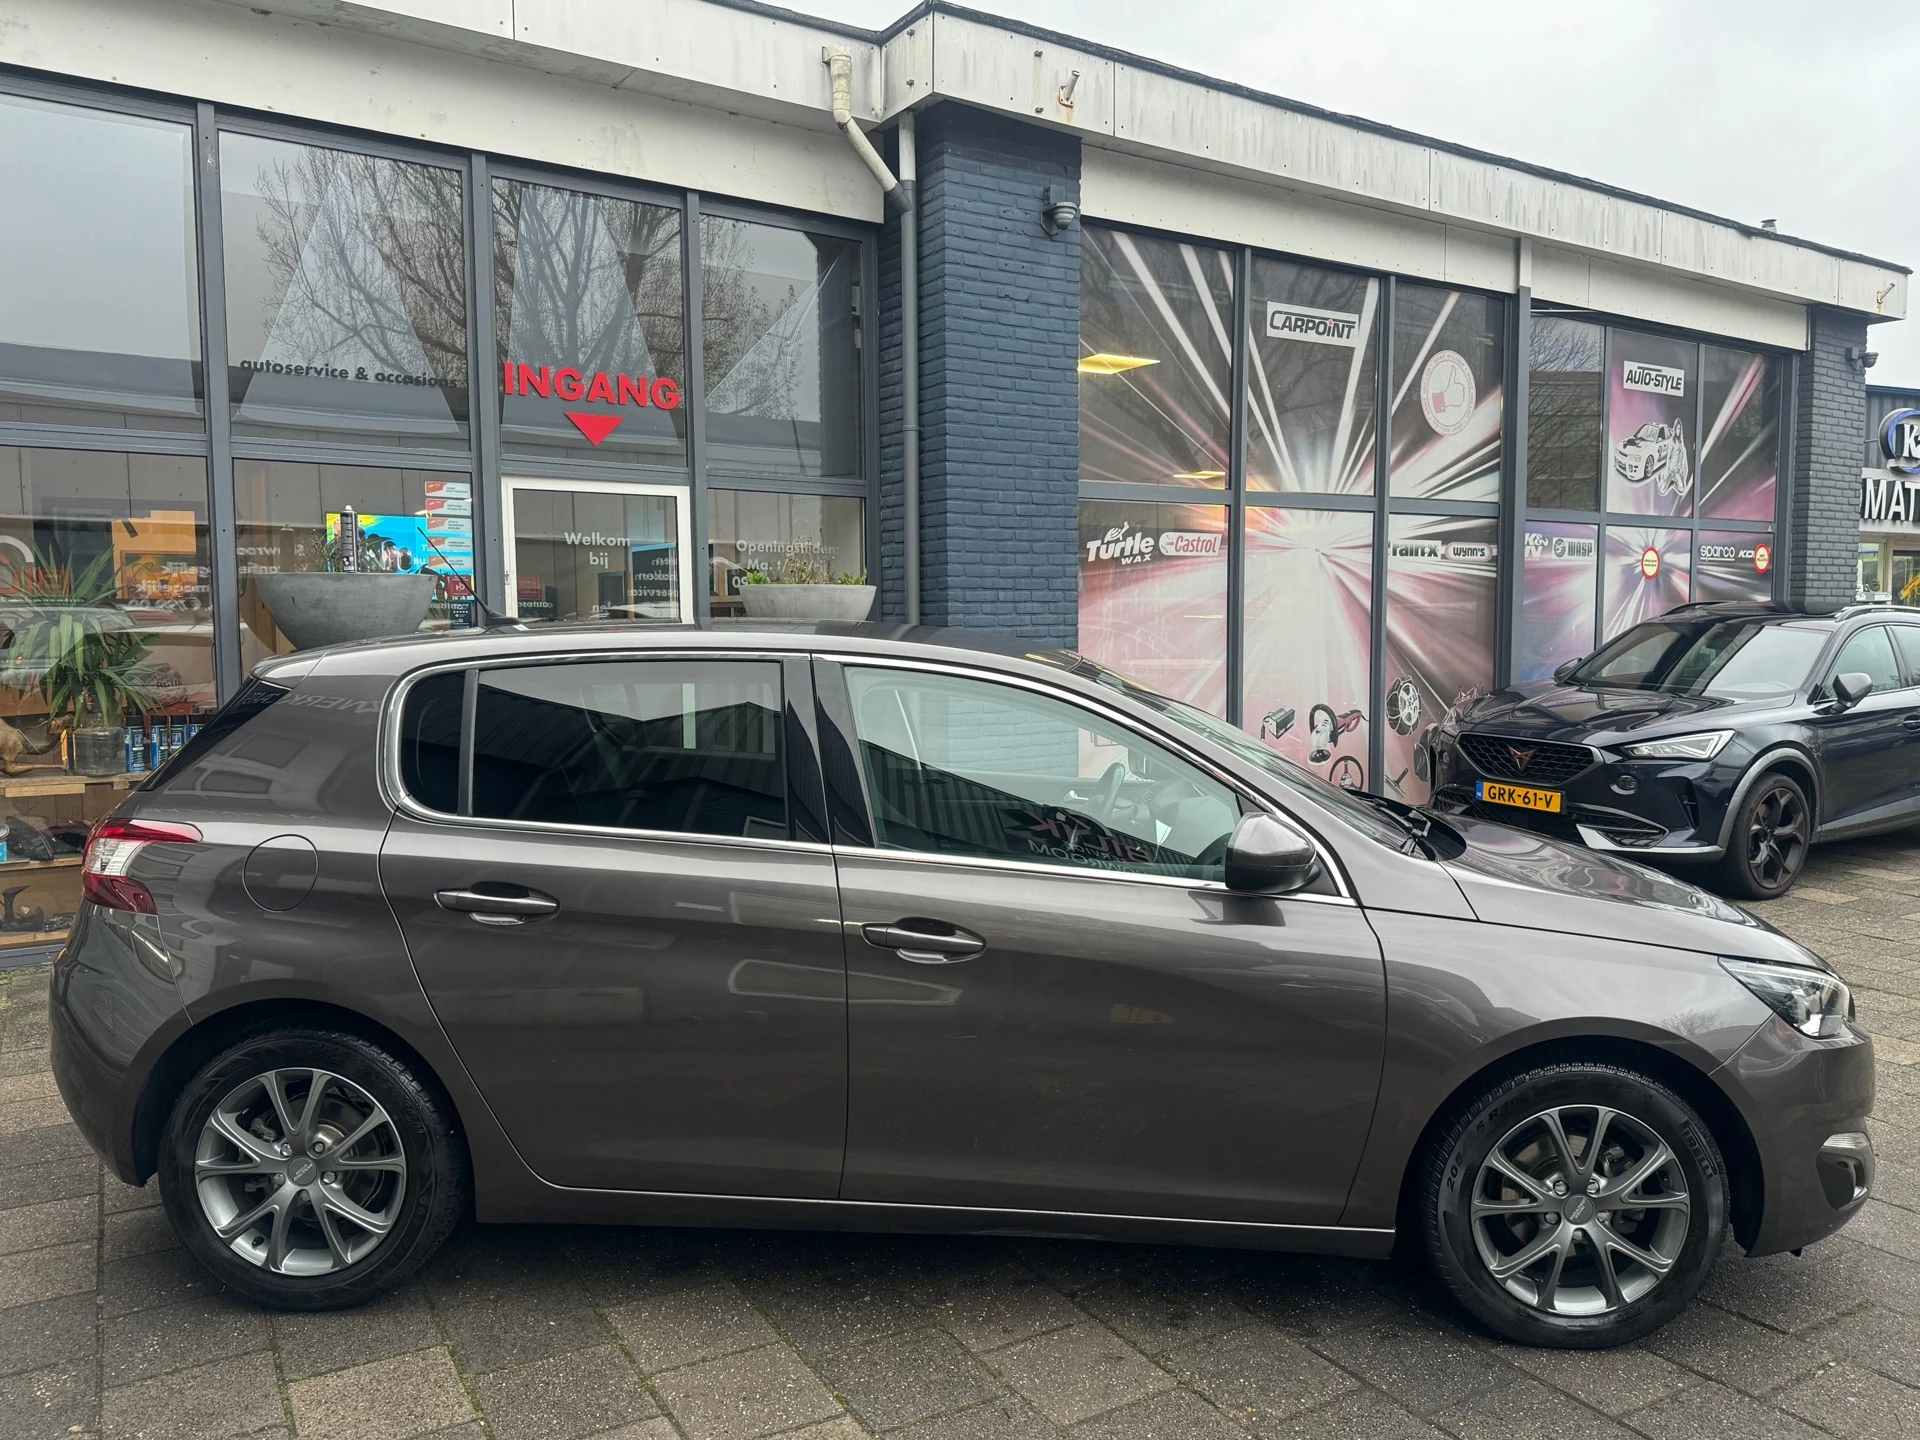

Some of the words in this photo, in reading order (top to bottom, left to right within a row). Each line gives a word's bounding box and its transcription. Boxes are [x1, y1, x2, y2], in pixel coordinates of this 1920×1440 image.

[1269, 310, 1356, 340] CARPOINT
[240, 360, 349, 379] autoservice
[355, 367, 369, 380] &
[374, 371, 457, 388] occasions
[1625, 366, 1682, 391] AUTO-STYLE
[504, 361, 681, 410] INGANG
[1861, 478, 1920, 521] MAT
[564, 532, 631, 547] Welkom
[1086, 532, 1155, 562] Turtle
[1174, 535, 1217, 553] Castrol
[1567, 541, 1593, 557] WASP
[589, 551, 609, 569] bij
[1121, 553, 1152, 566] WAX
[1700, 544, 1735, 562] sparco
[1738, 549, 1755, 558] KO
[747, 559, 772, 571] Ma.
[1488, 785, 1554, 809] GRK-61-V
[1677, 1118, 1718, 1180] PIRELLI
